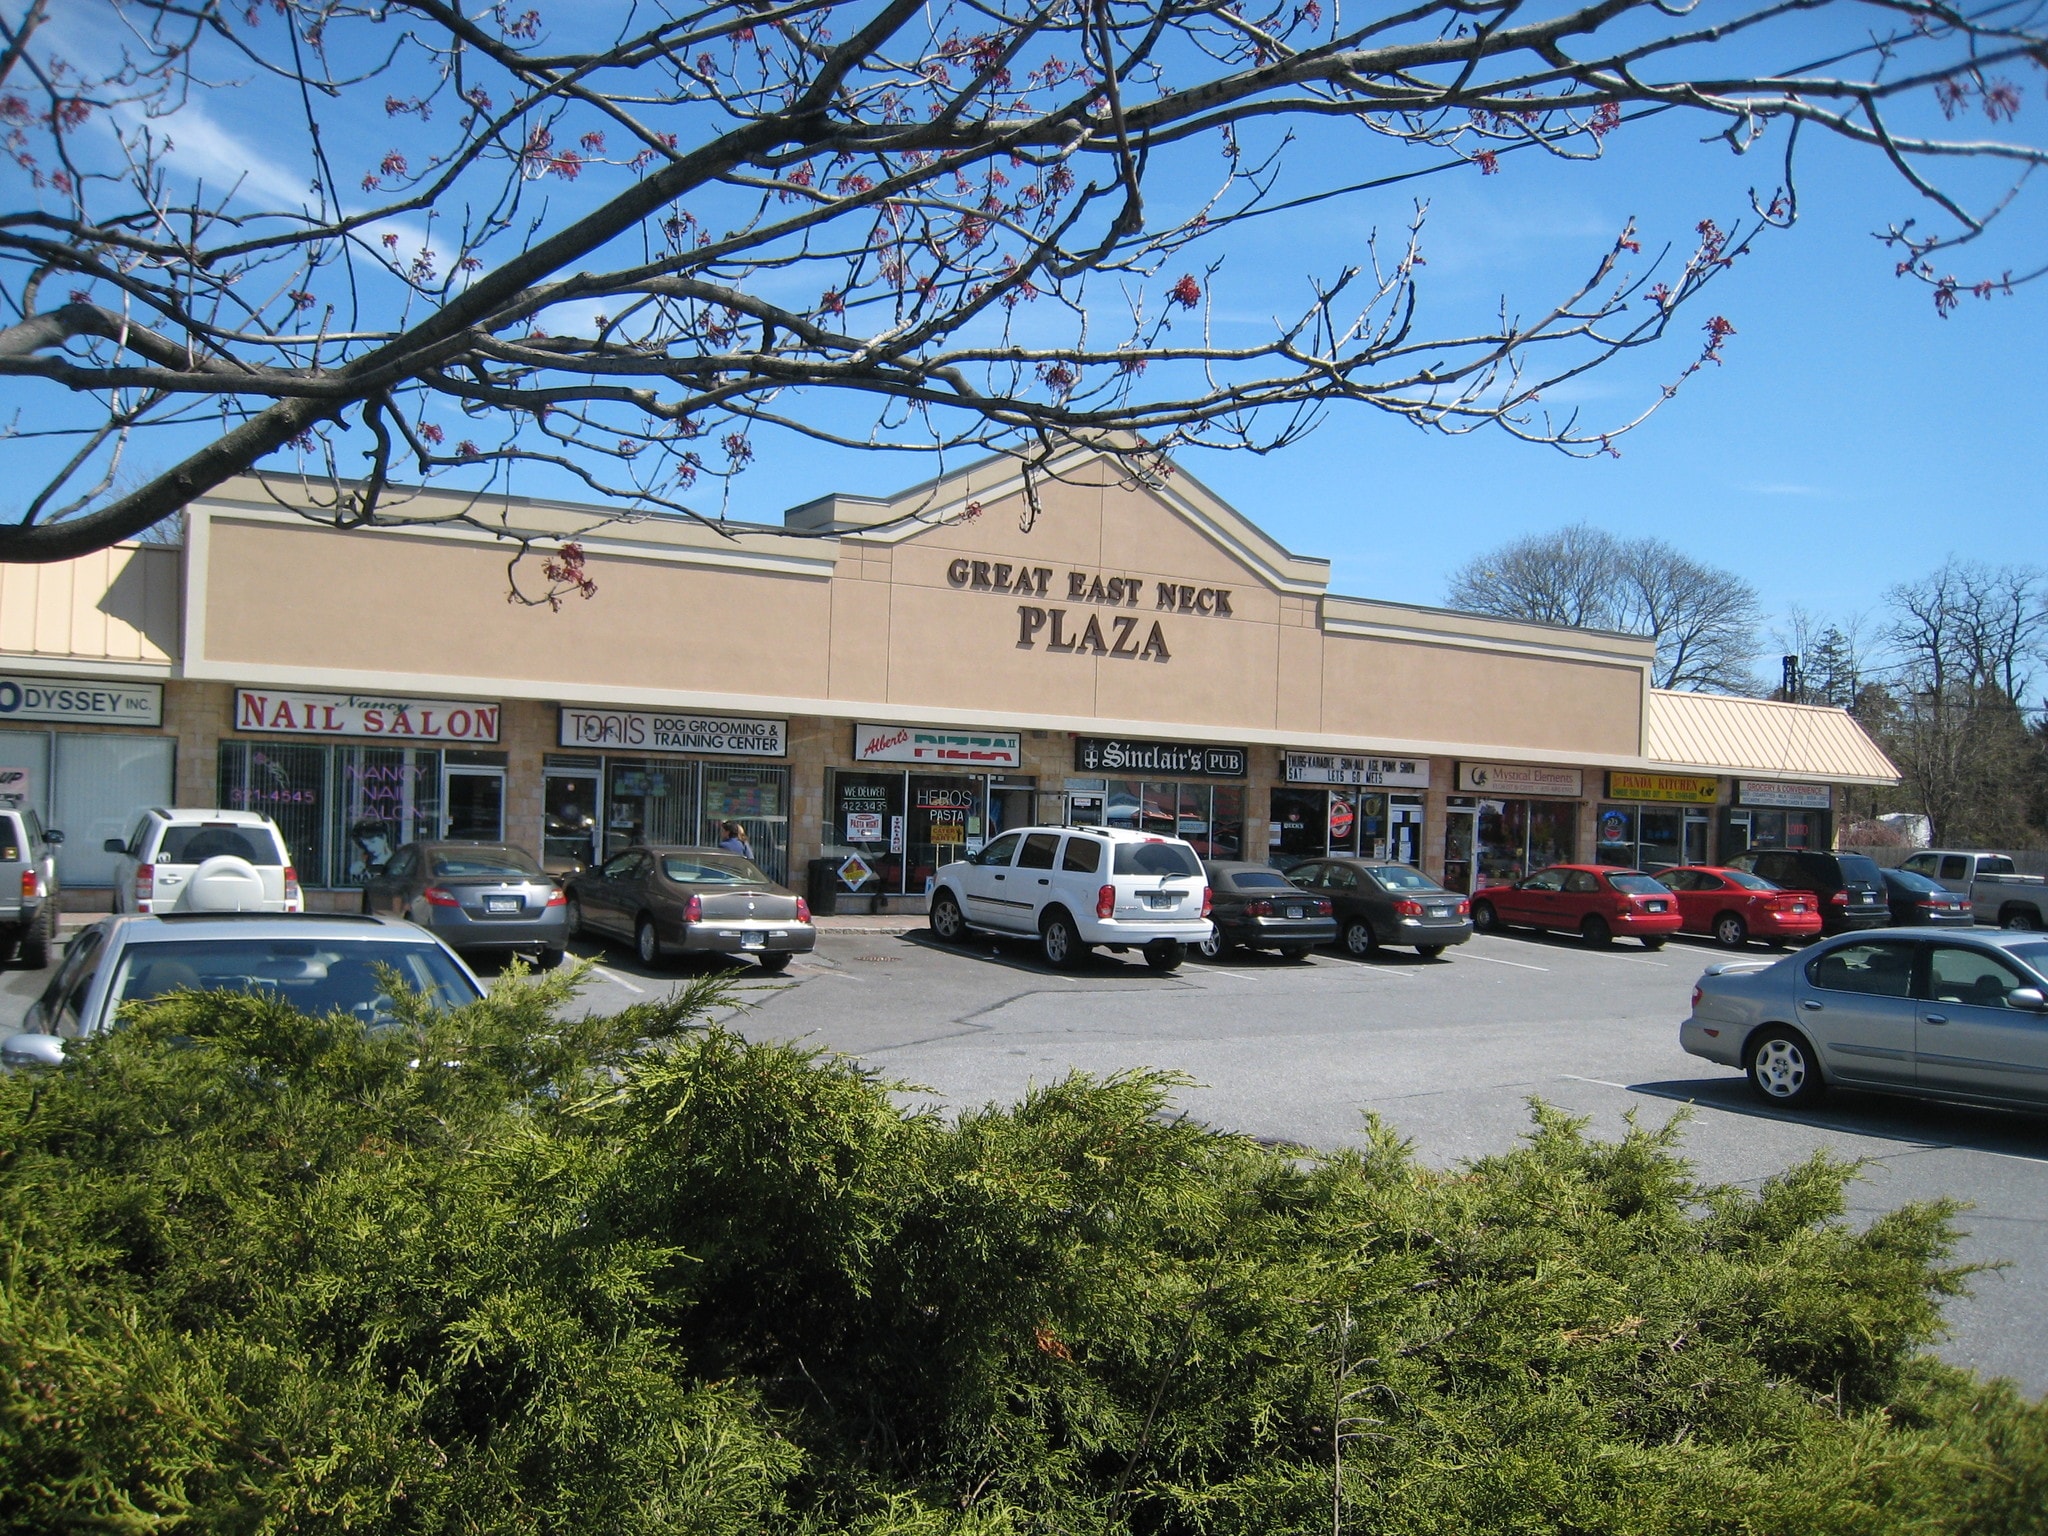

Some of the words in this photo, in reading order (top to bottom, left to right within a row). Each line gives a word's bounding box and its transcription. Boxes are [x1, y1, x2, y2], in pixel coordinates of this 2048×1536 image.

[948, 558, 1053, 594] GREAT
[1068, 571, 1143, 603] EAST
[1157, 582, 1233, 615] NECK
[1016, 605, 1172, 660] PLAZA
[0, 682, 122, 713] ODYSSEY
[126, 698, 151, 710] INC.
[334, 695, 413, 717] Nancy
[242, 693, 344, 731] NAIL
[363, 708, 497, 738] SALON
[654, 718, 686, 732] DOG
[689, 721, 766, 736] GROOMING
[769, 725, 778, 736] &
[654, 732, 724, 748] TRAINING
[728, 736, 778, 751] CENTER
[863, 729, 909, 758] Albert's
[914, 734, 1012, 761] PIZZA
[1102, 741, 1202, 771] Sinclair's
[1210, 754, 1239, 769] PUB
[346, 765, 427, 781] NANCY
[1327, 770, 1344, 782] LETS
[1352, 771, 1361, 783] GO
[1366, 772, 1383, 784] METS
[1493, 768, 1530, 781] Mystical
[1535, 770, 1574, 783] Elements
[844, 786, 855, 797] WE
[857, 787, 885, 797] DELIVER
[1623, 775, 1652, 788] PANDA
[1658, 777, 1698, 791] KITCHEN
[1747, 783, 1774, 792] GROCERY
[1783, 785, 1823, 794] CONVENIENCE
[917, 789, 973, 807] HEROS
[930, 809, 964, 821] PASTA
